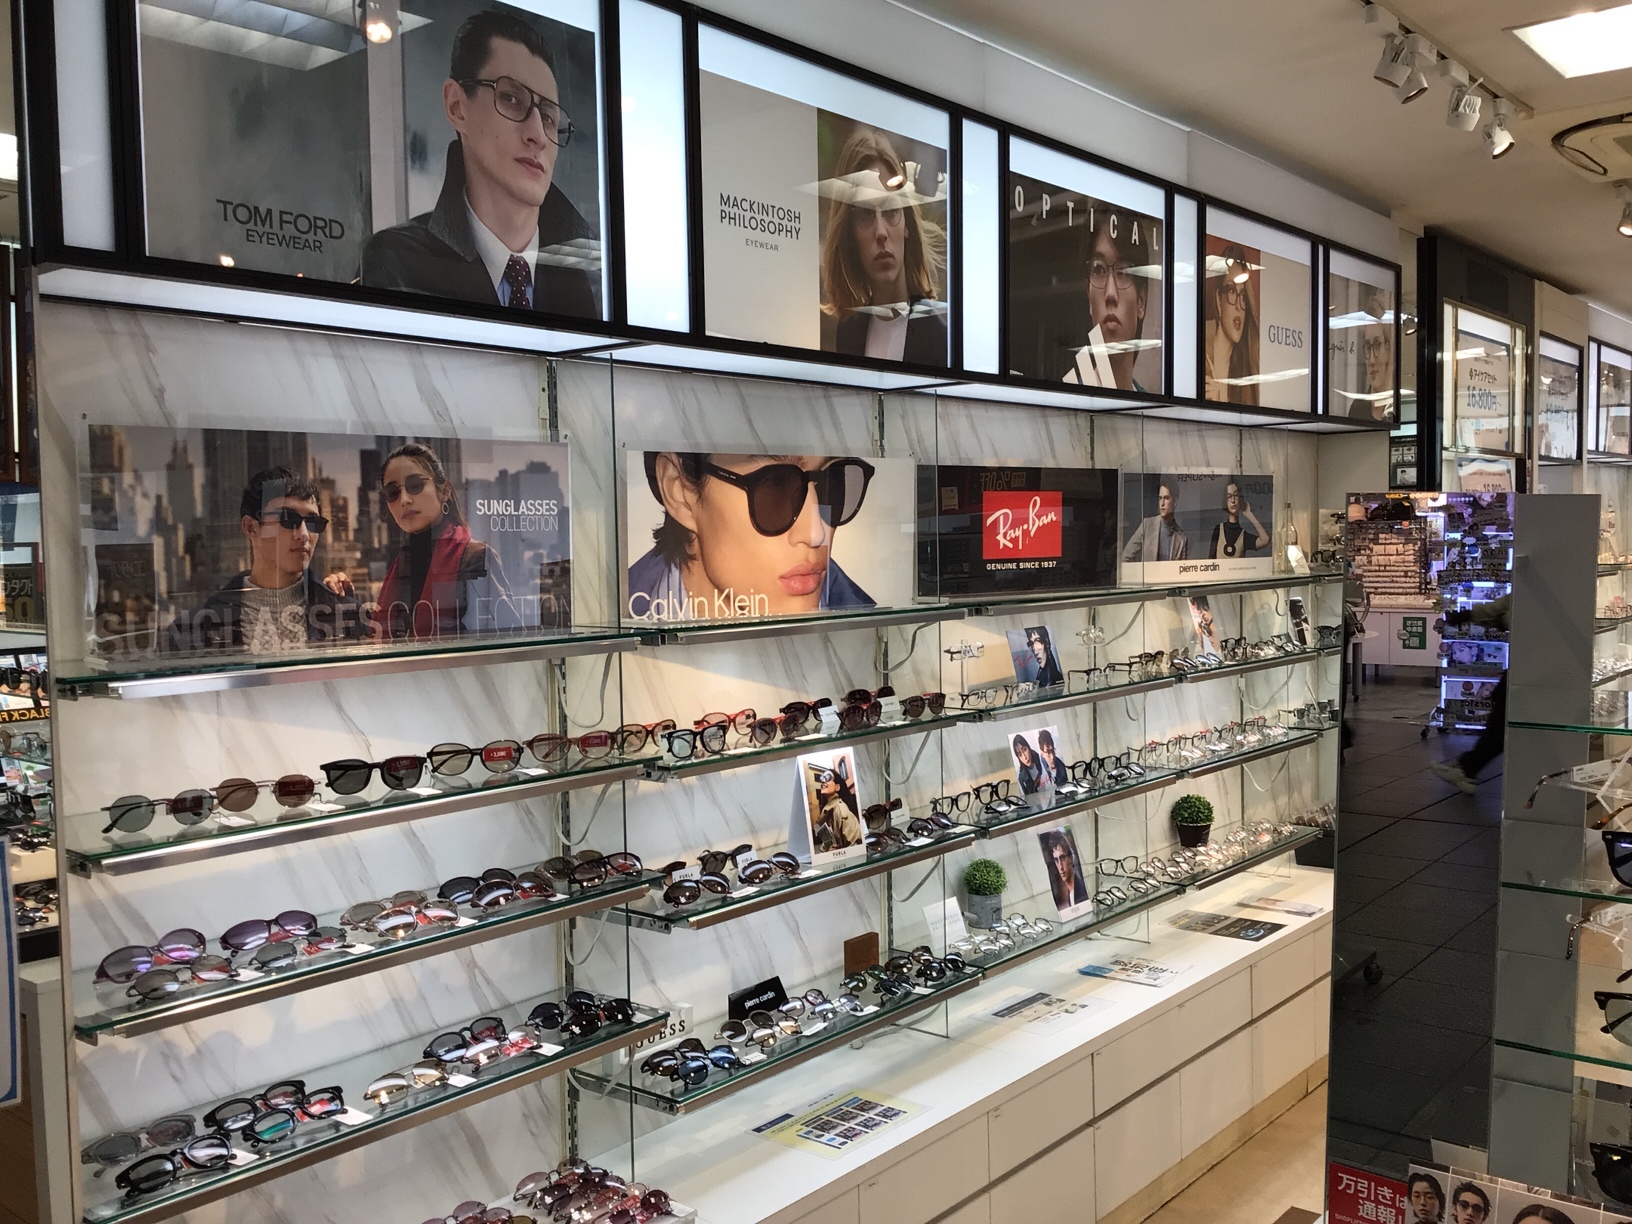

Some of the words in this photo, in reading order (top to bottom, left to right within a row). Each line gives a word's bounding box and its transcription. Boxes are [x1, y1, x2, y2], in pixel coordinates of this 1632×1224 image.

[216, 199, 273, 229] TOM
[279, 210, 345, 240] FORD
[720, 192, 801, 225] MACKINTOSH
[1014, 185, 1159, 250] OPTICAL
[720, 209, 801, 240] PHILOSOPHY
[246, 229, 322, 253] EYEWEAR
[745, 238, 779, 252] EYEWEAR
[1268, 325, 1303, 348] GUESS
[476, 500, 558, 515] SUNGLASSES
[490, 516, 559, 531] COLLECTION
[1179, 564, 1198, 575] pierre
[1200, 562, 1220, 571] cardin
[629, 590, 709, 621] Calvin
[714, 588, 769, 617] Klein
[745, 998, 759, 1009] pierre
[760, 991, 775, 1001] cardin
[1337, 1173, 1407, 1210] 万引きは
